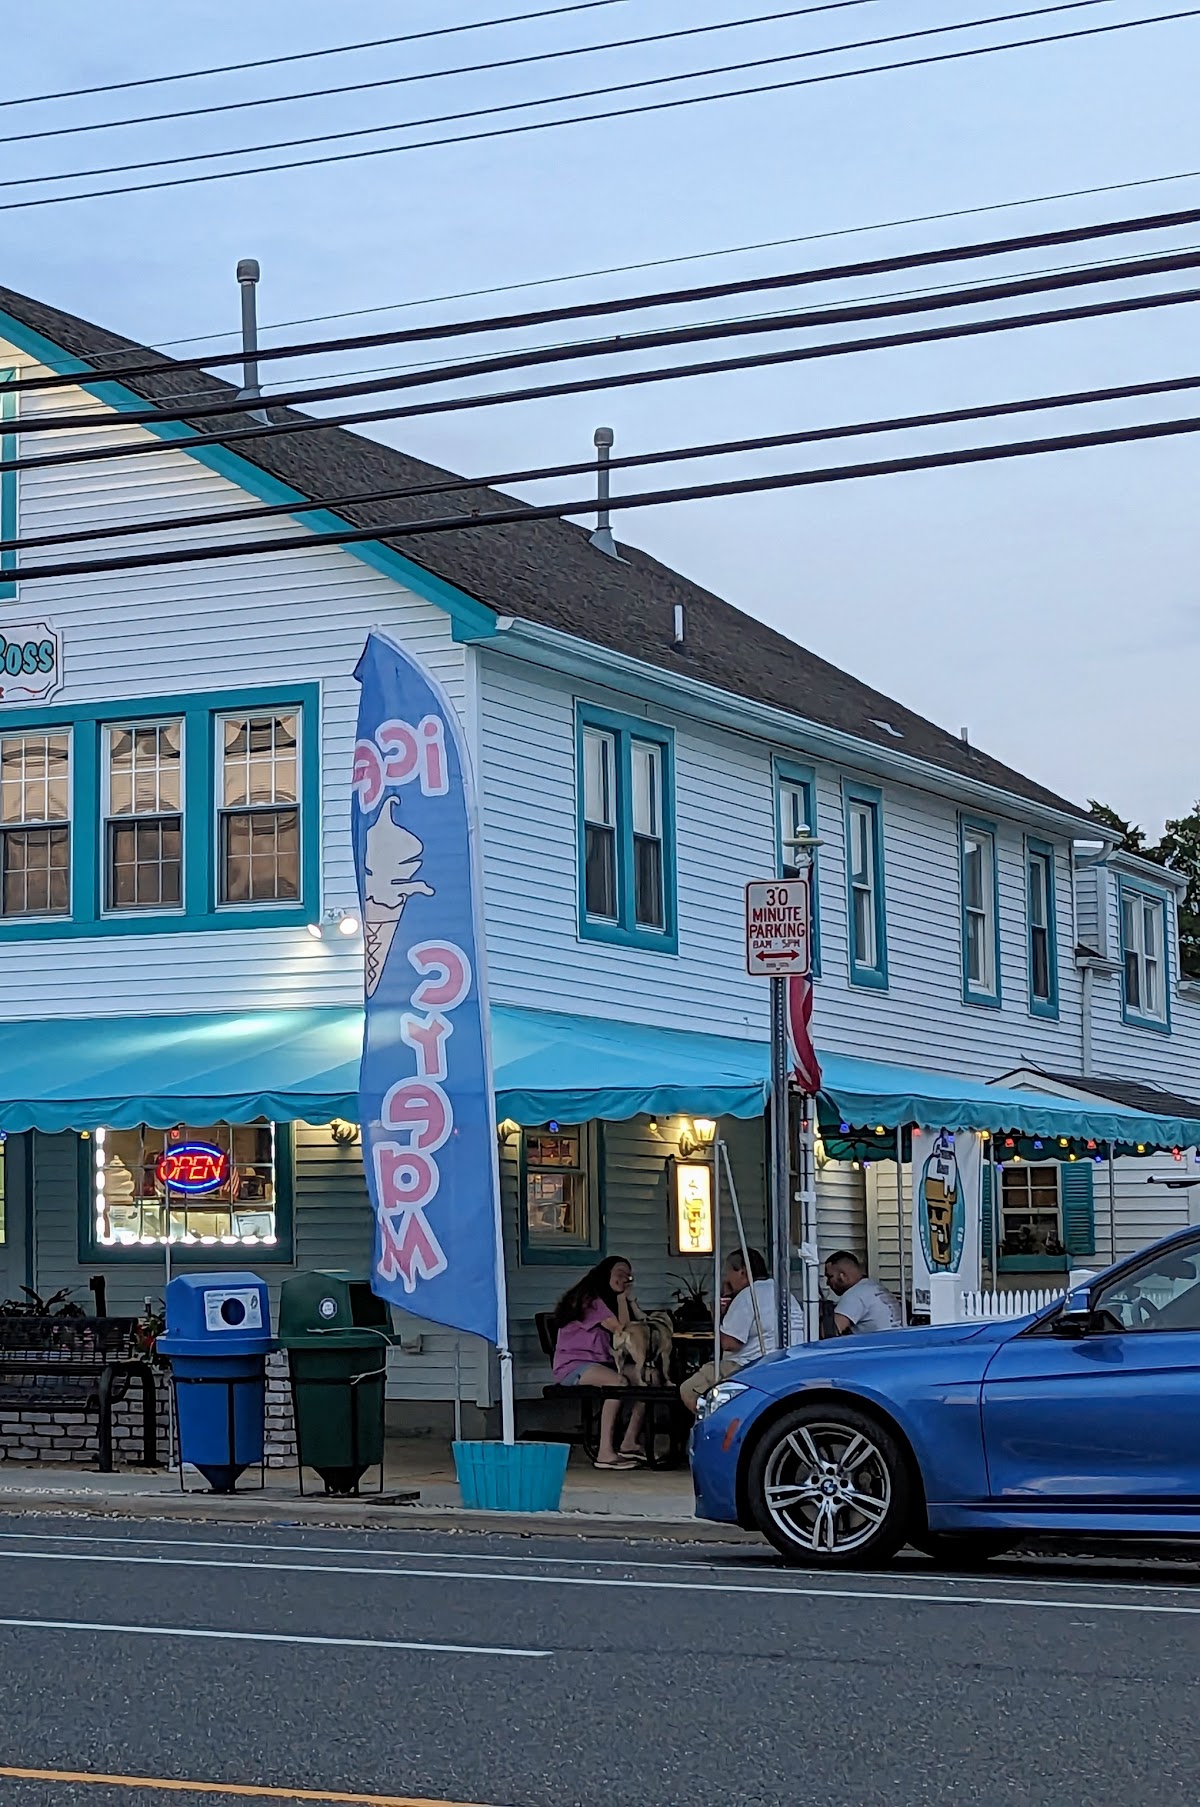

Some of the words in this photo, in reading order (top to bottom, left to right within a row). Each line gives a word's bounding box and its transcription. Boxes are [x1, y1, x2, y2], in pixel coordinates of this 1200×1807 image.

[766, 889, 788, 906] 30
[752, 907, 802, 922] MINUTE
[749, 922, 806, 939] PARKING
[160, 1154, 225, 1181] OPEN
